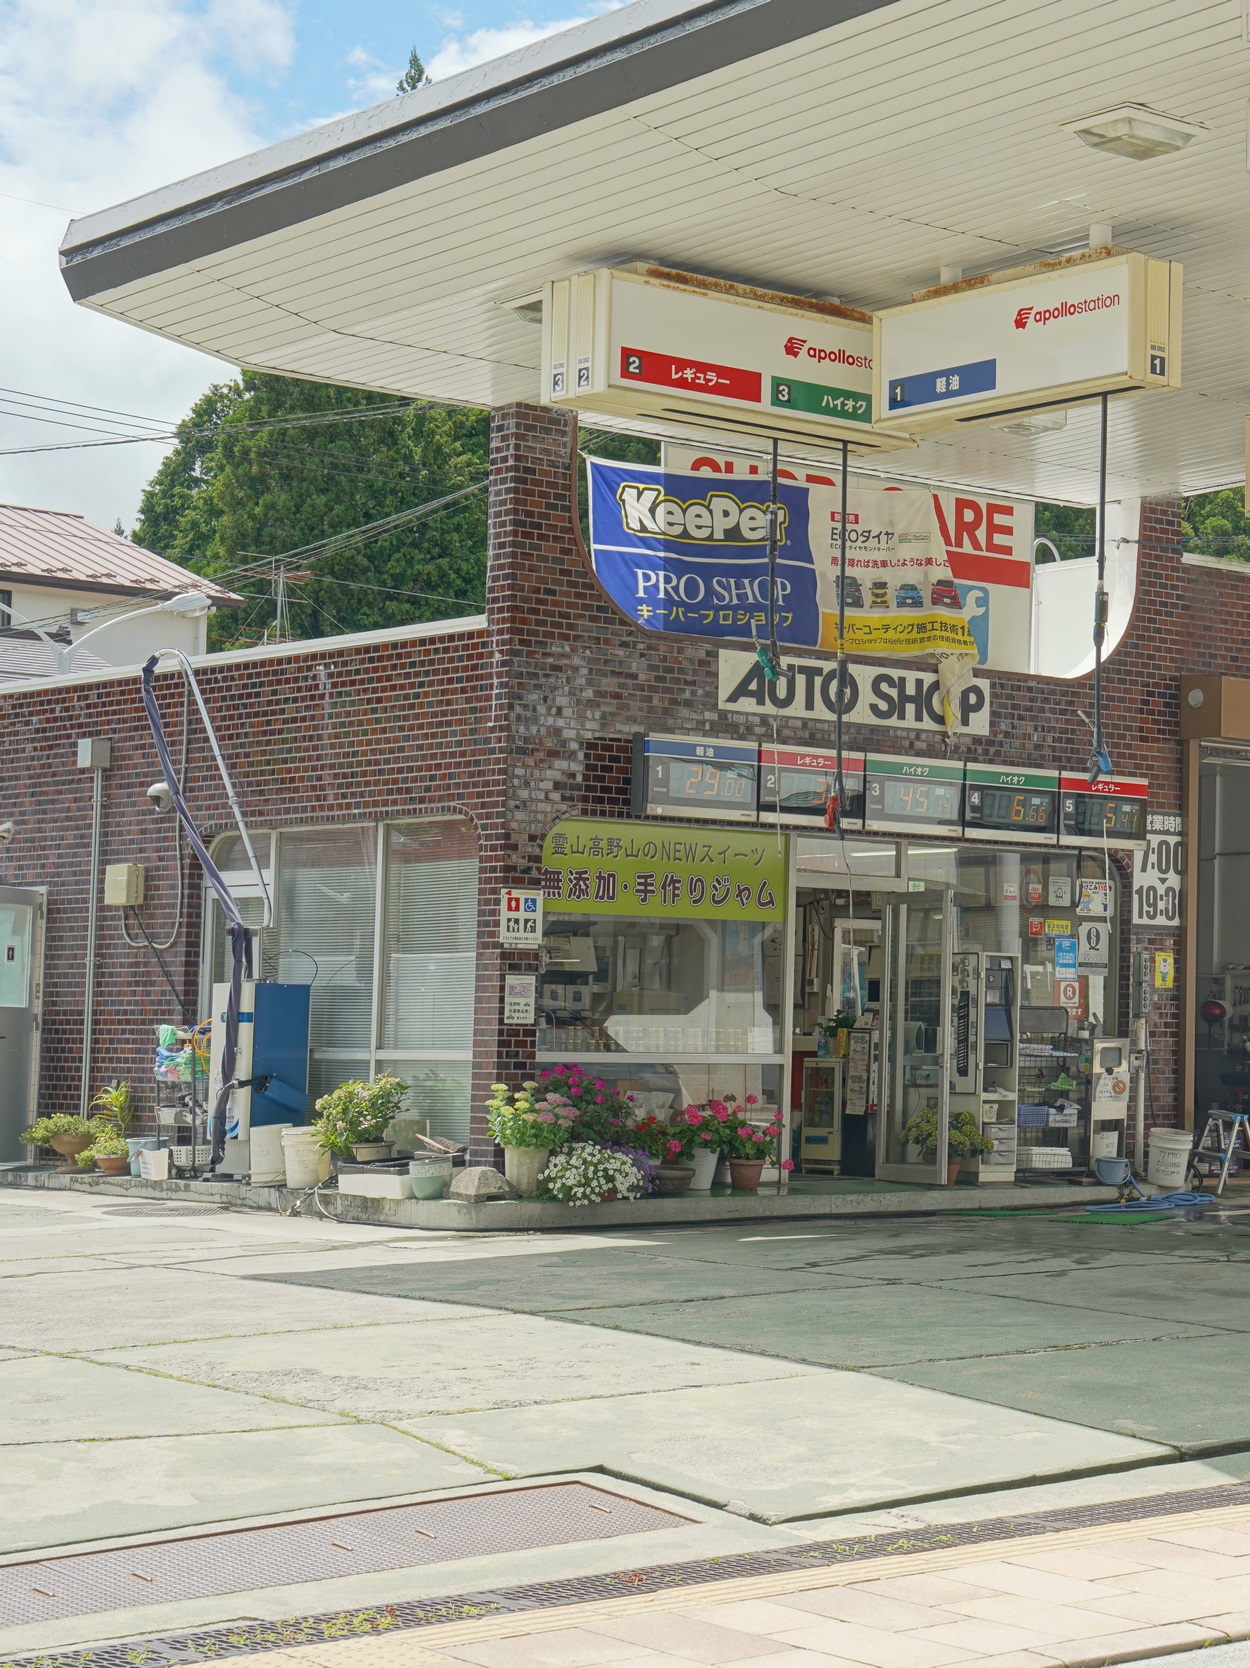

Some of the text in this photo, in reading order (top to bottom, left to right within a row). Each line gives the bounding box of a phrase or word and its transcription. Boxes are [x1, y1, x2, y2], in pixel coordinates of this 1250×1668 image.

[1034, 293, 1120, 325] apollostation
[628, 356, 730, 387] 2 レギュラー
[1153, 357, 1162, 374] 1
[553, 374, 564, 391] 3
[578, 368, 588, 386] 2
[895, 375, 960, 401] 1 軽油
[778, 385, 866, 414] 3 ハイオク
[834, 513, 856, 523] 新売
[634, 568, 791, 606] PRO SHOP
[725, 660, 985, 727] AUTO SHOP
[695, 746, 714, 757] 軽油
[797, 756, 832, 766] レギュラー
[655, 766, 663, 778] 1
[902, 766, 930, 775] ハイオク
[766, 775, 775, 788] 2
[1000, 775, 1025, 785] ハイオク
[1091, 784, 1121, 792] レギュラー
[872, 784, 880, 796] 3
[971, 793, 979, 804] 4
[1065, 800, 1073, 812] 5
[551, 833, 766, 867] 霊山高野山のNEWスイーツ
[540, 866, 777, 909] 無添加・手作りジャム
[1135, 885, 1181, 922] 19:3
